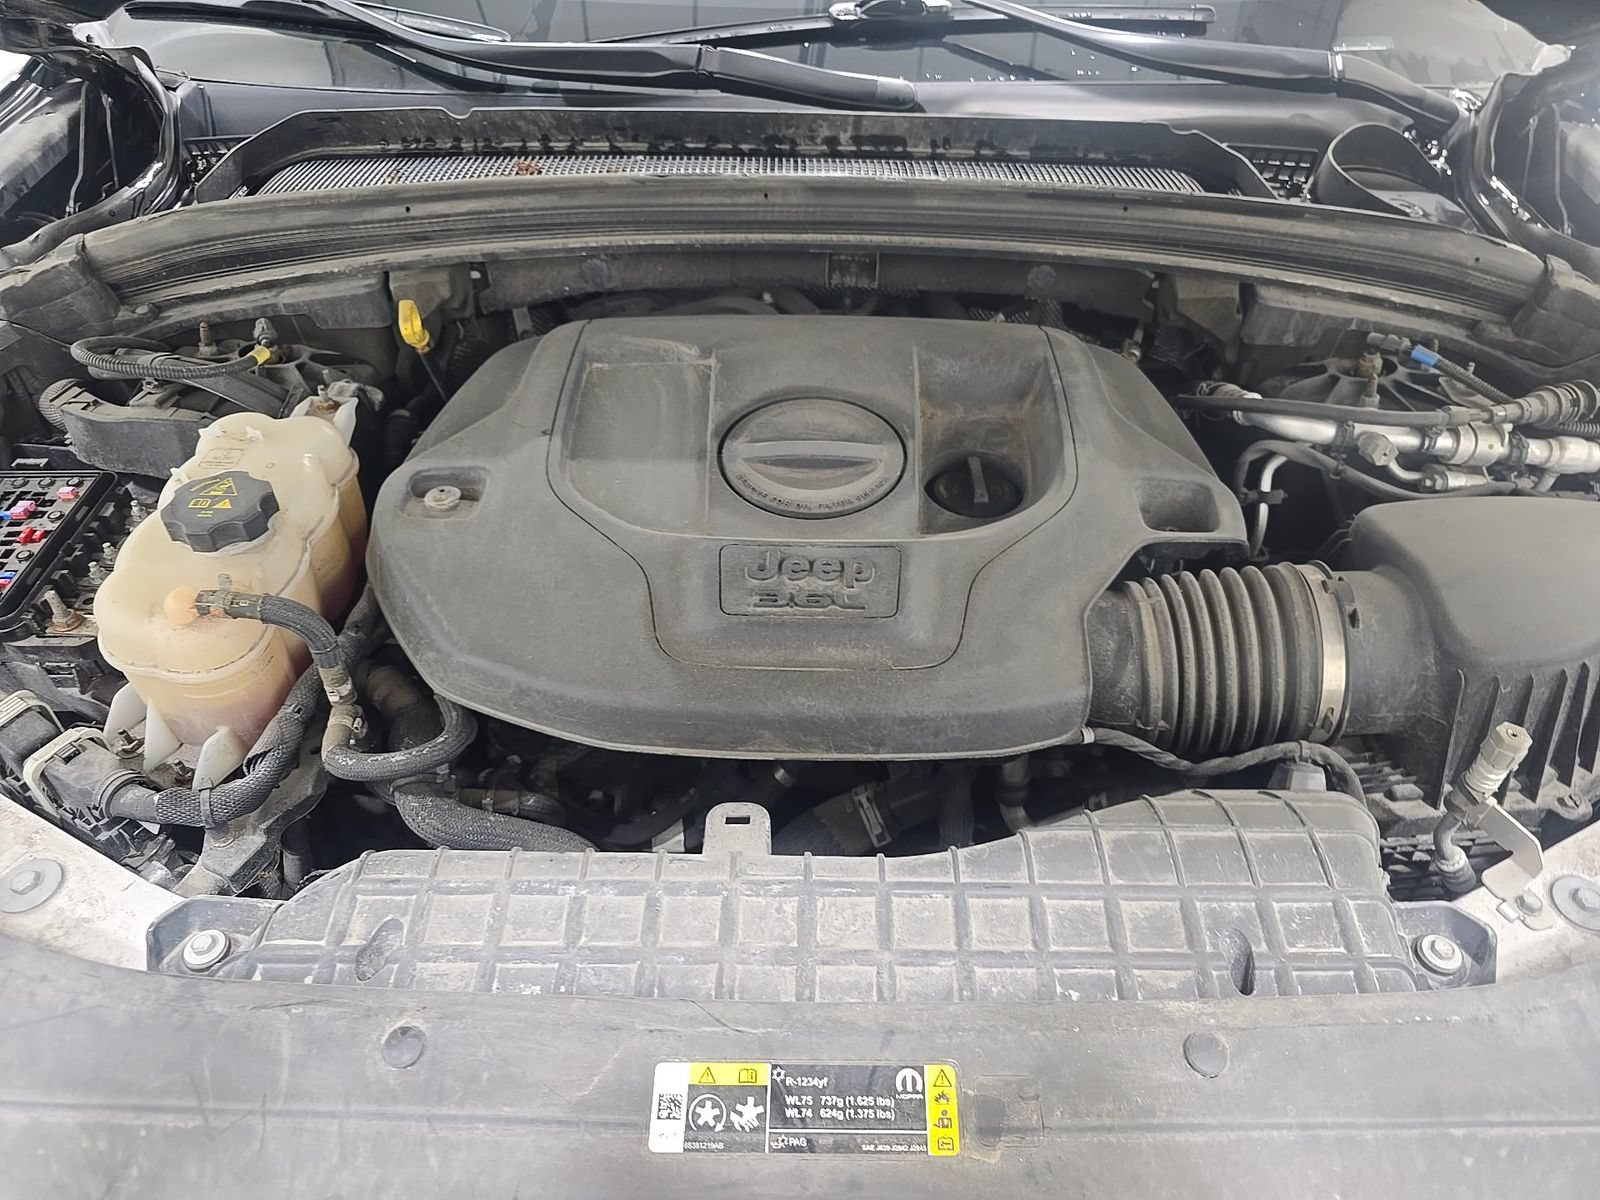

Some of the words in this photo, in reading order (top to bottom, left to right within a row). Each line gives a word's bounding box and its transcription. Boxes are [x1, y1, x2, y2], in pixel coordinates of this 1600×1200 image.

[744, 550, 876, 589] Jeep
[752, 592, 866, 609] 3.6L
[785, 1076, 829, 1088] R-1234yf
[785, 1095, 813, 1106] WL75
[820, 1095, 844, 1108] 737g
[845, 1095, 875, 1108] (1.625
[876, 1096, 895, 1108] lbs)
[785, 1108, 813, 1118] WL74
[820, 1108, 844, 1120] 624g
[845, 1108, 875, 1120] (1.375
[876, 1108, 895, 1120] lbs)
[788, 1137, 807, 1147] PAG
